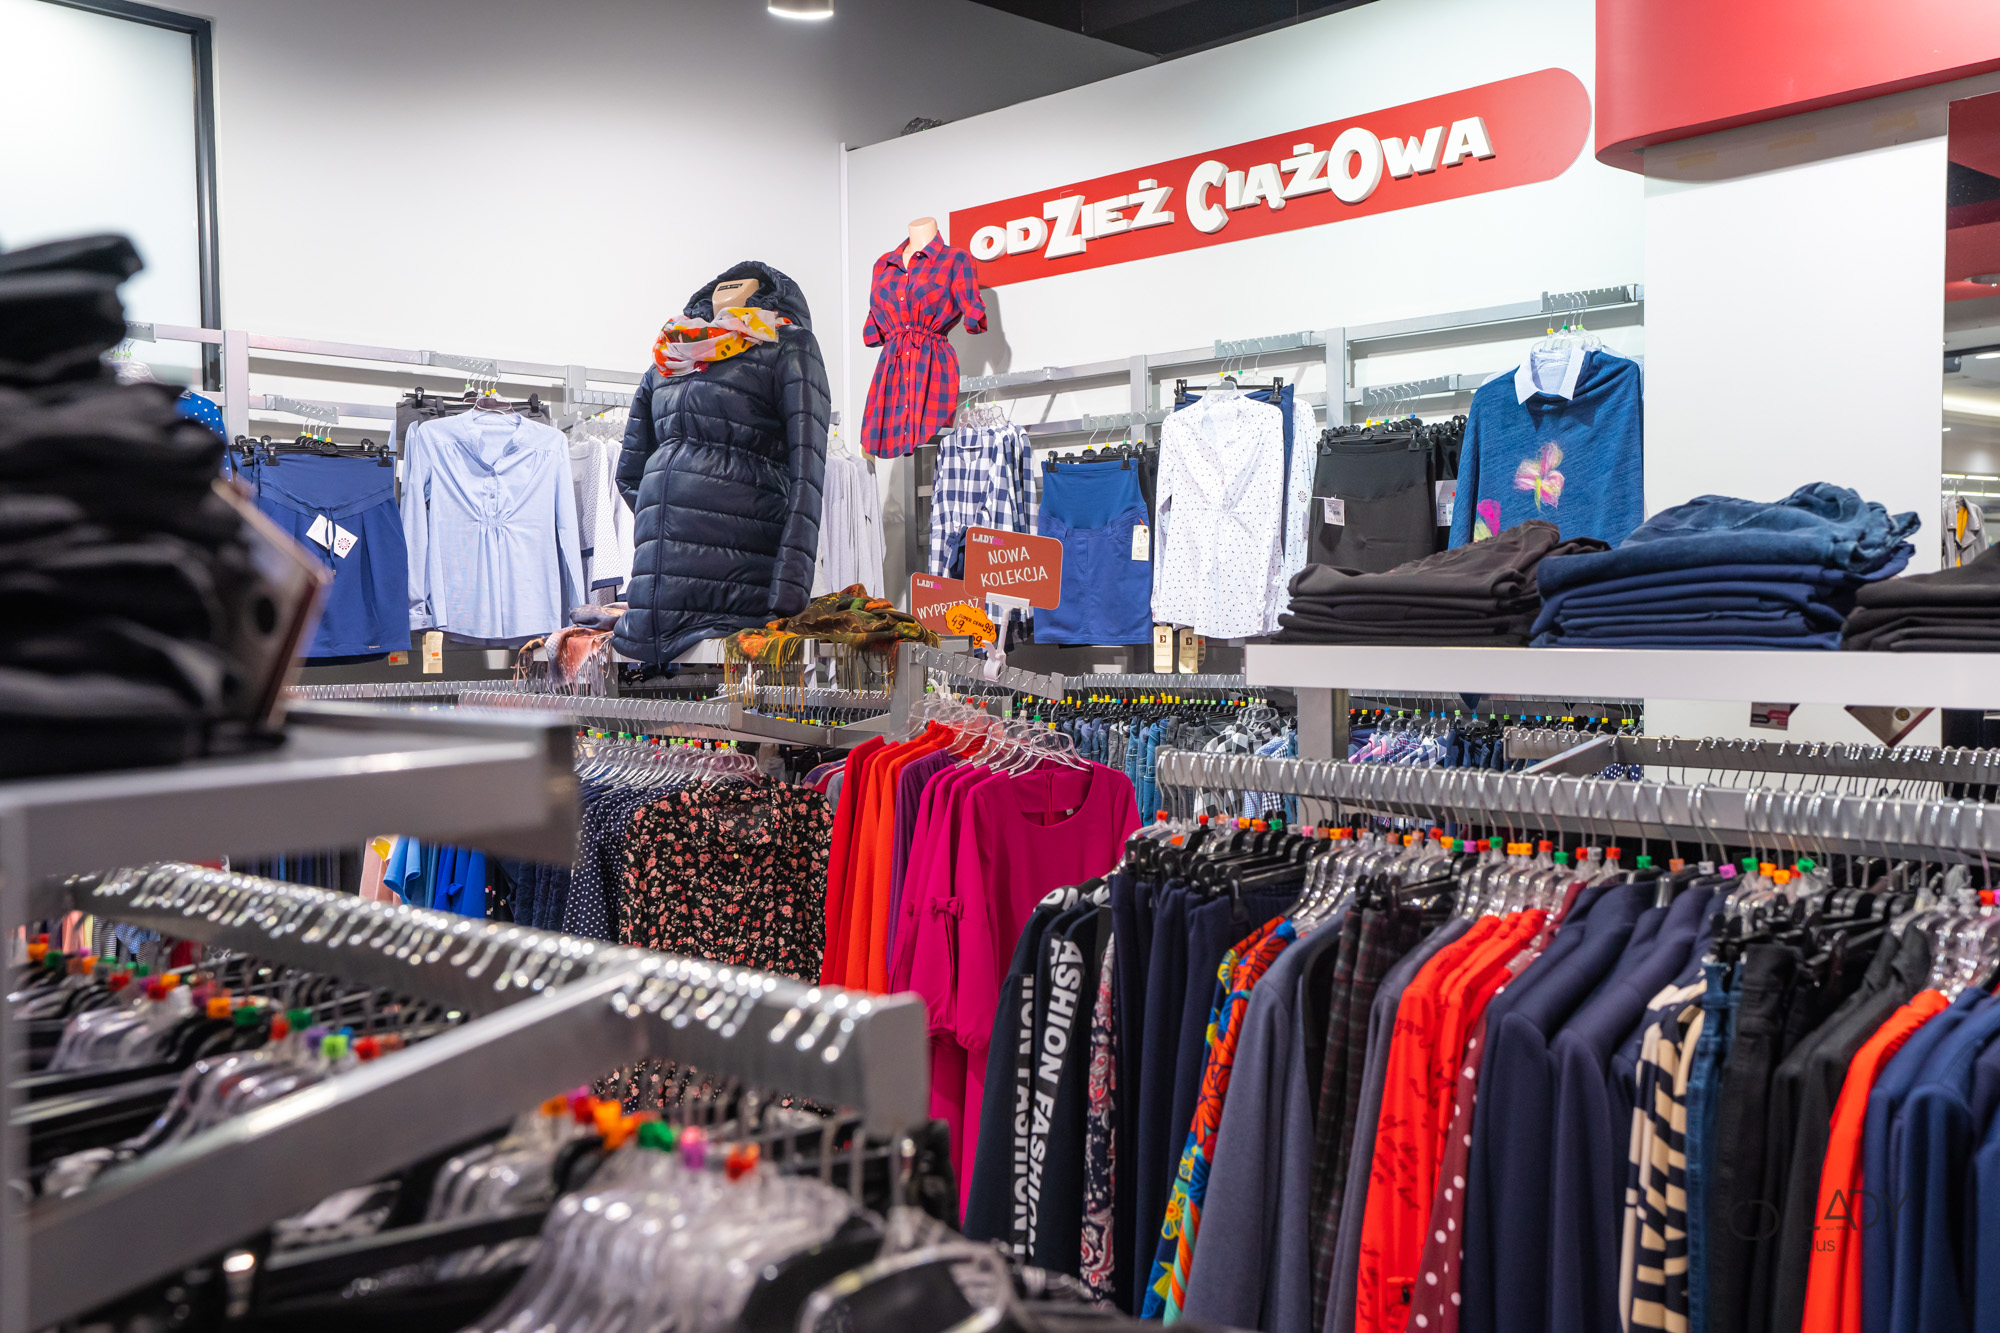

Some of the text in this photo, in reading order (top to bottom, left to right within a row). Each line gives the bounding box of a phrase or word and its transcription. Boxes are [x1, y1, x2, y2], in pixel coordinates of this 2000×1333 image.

[969, 116, 1495, 262] ODZIEŻ CIĄŻOWA
[980, 565, 1049, 588] KOLEKCJA
[987, 546, 1030, 565] NOWA
[1038, 940, 1084, 1085] ASHION
